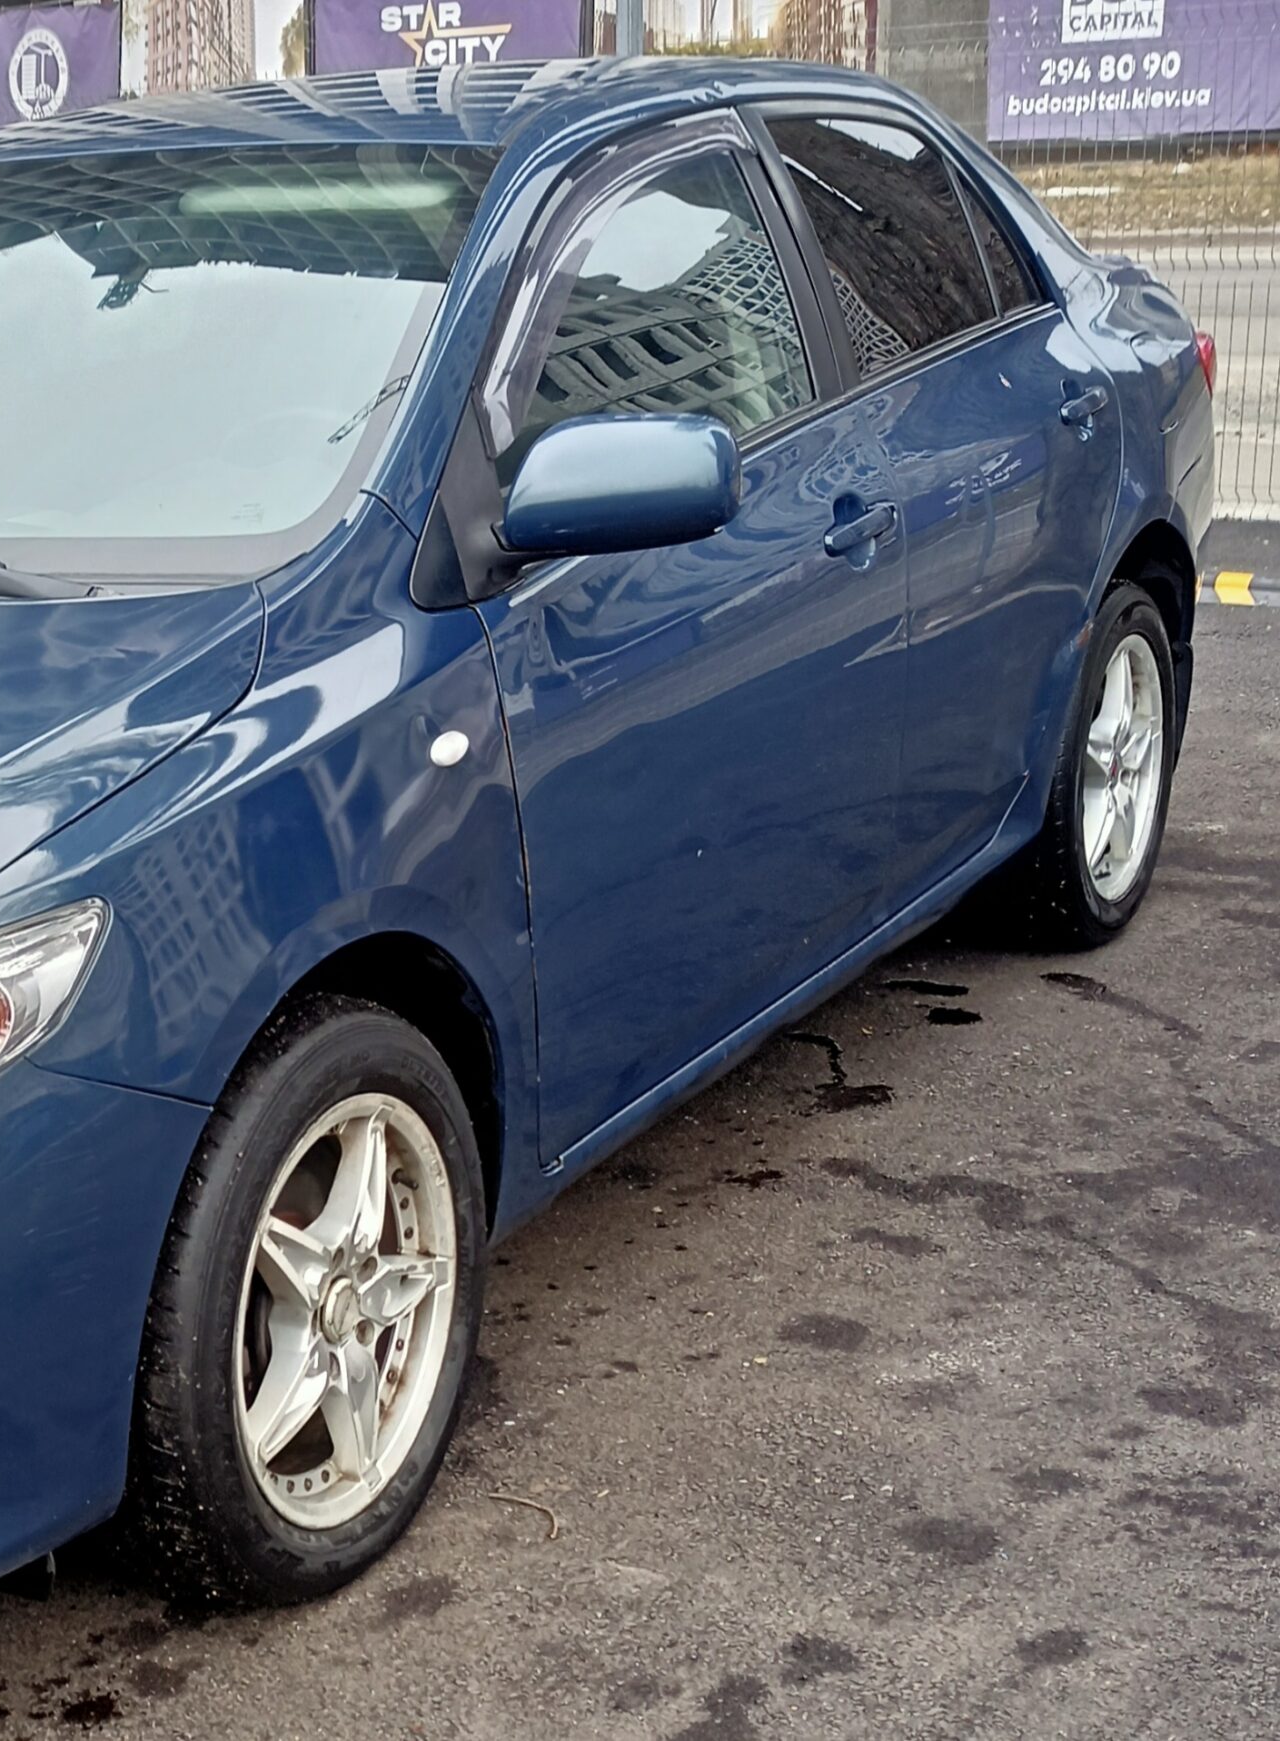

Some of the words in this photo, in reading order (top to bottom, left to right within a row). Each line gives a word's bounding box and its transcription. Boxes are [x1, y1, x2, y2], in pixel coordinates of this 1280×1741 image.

[380, 0, 462, 32] STAR
[1069, 10, 1159, 33] CAPITAL
[424, 35, 506, 66] CITY
[1039, 56, 1092, 87] 294
[1099, 53, 1136, 83] 80
[1143, 50, 1181, 80] 90
